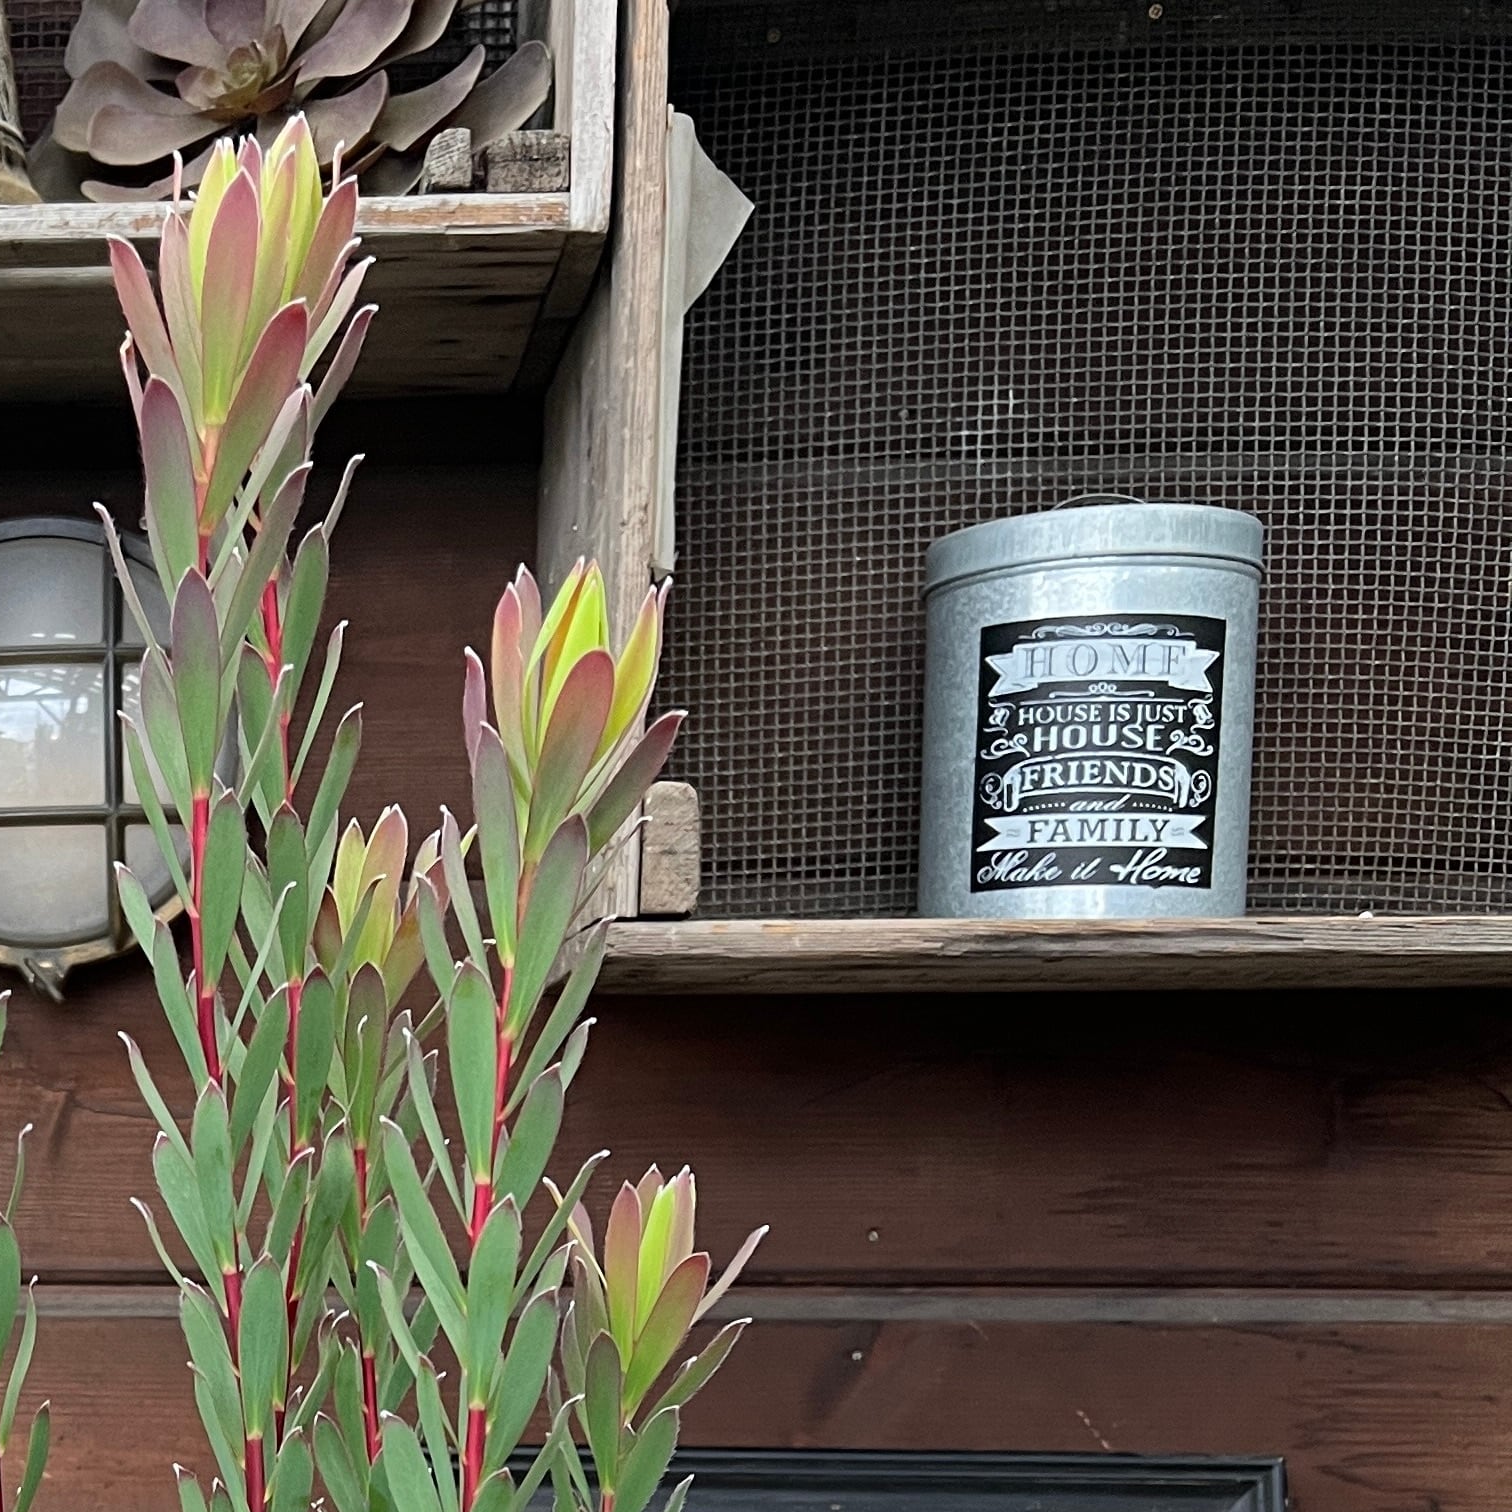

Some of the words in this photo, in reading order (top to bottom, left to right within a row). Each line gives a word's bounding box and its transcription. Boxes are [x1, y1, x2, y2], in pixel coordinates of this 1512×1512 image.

[1018, 704, 1102, 725] HOUSE
[1108, 703, 1131, 723] IS
[1136, 703, 1189, 730] JUST
[1033, 724, 1166, 752] HOUSE
[1020, 759, 1177, 792] FRIENDS
[1068, 793, 1132, 812] and
[1026, 818, 1171, 845] FAMILY
[976, 849, 1063, 884] Make
[1108, 847, 1202, 885] Home
